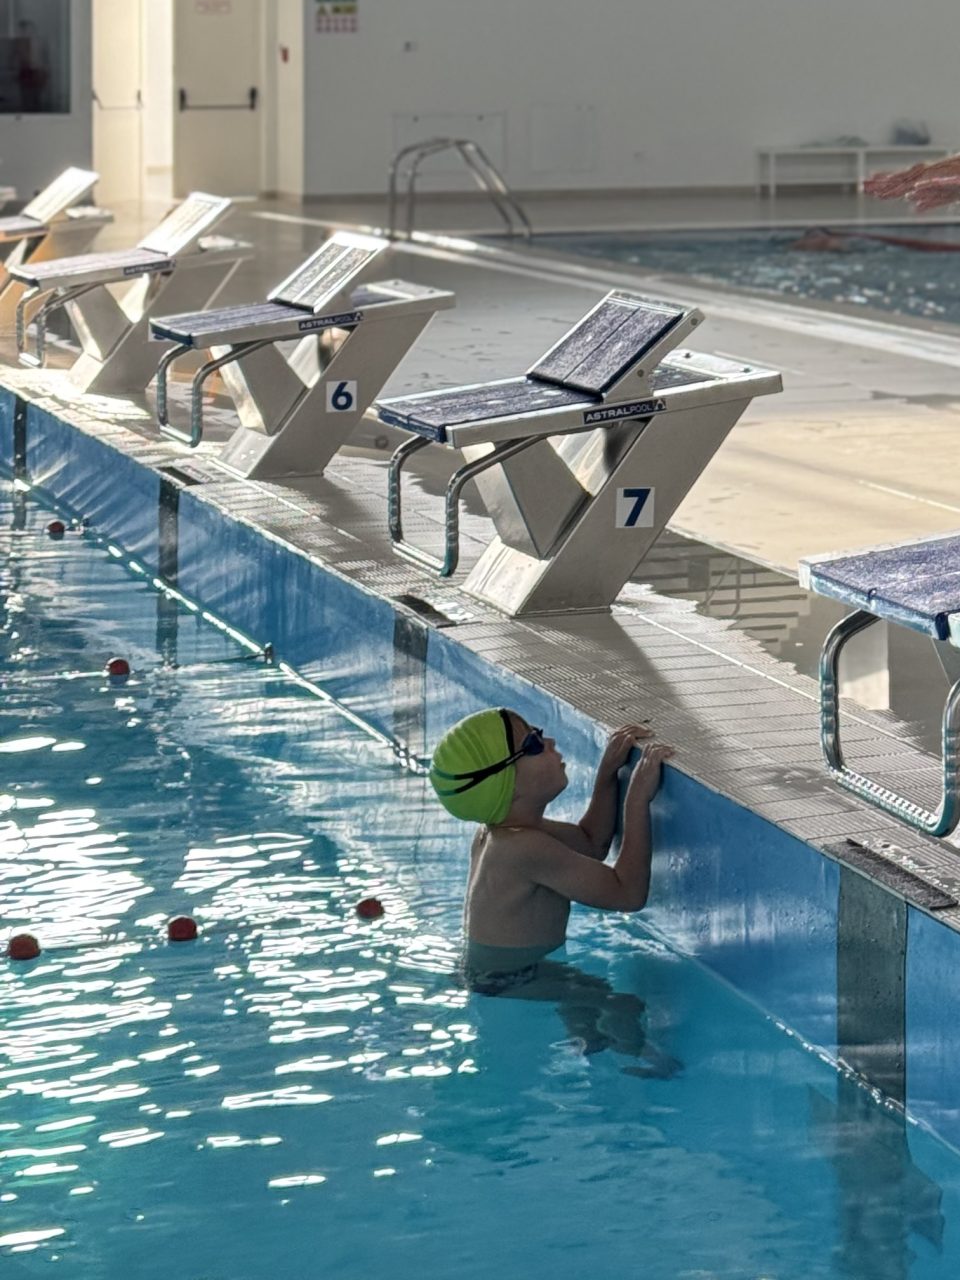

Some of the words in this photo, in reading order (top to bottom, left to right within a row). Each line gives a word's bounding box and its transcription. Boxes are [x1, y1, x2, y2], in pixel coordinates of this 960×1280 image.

[331, 381, 353, 411] 6
[586, 404, 653, 422] ASTRALPOOL
[623, 488, 651, 526] 7
